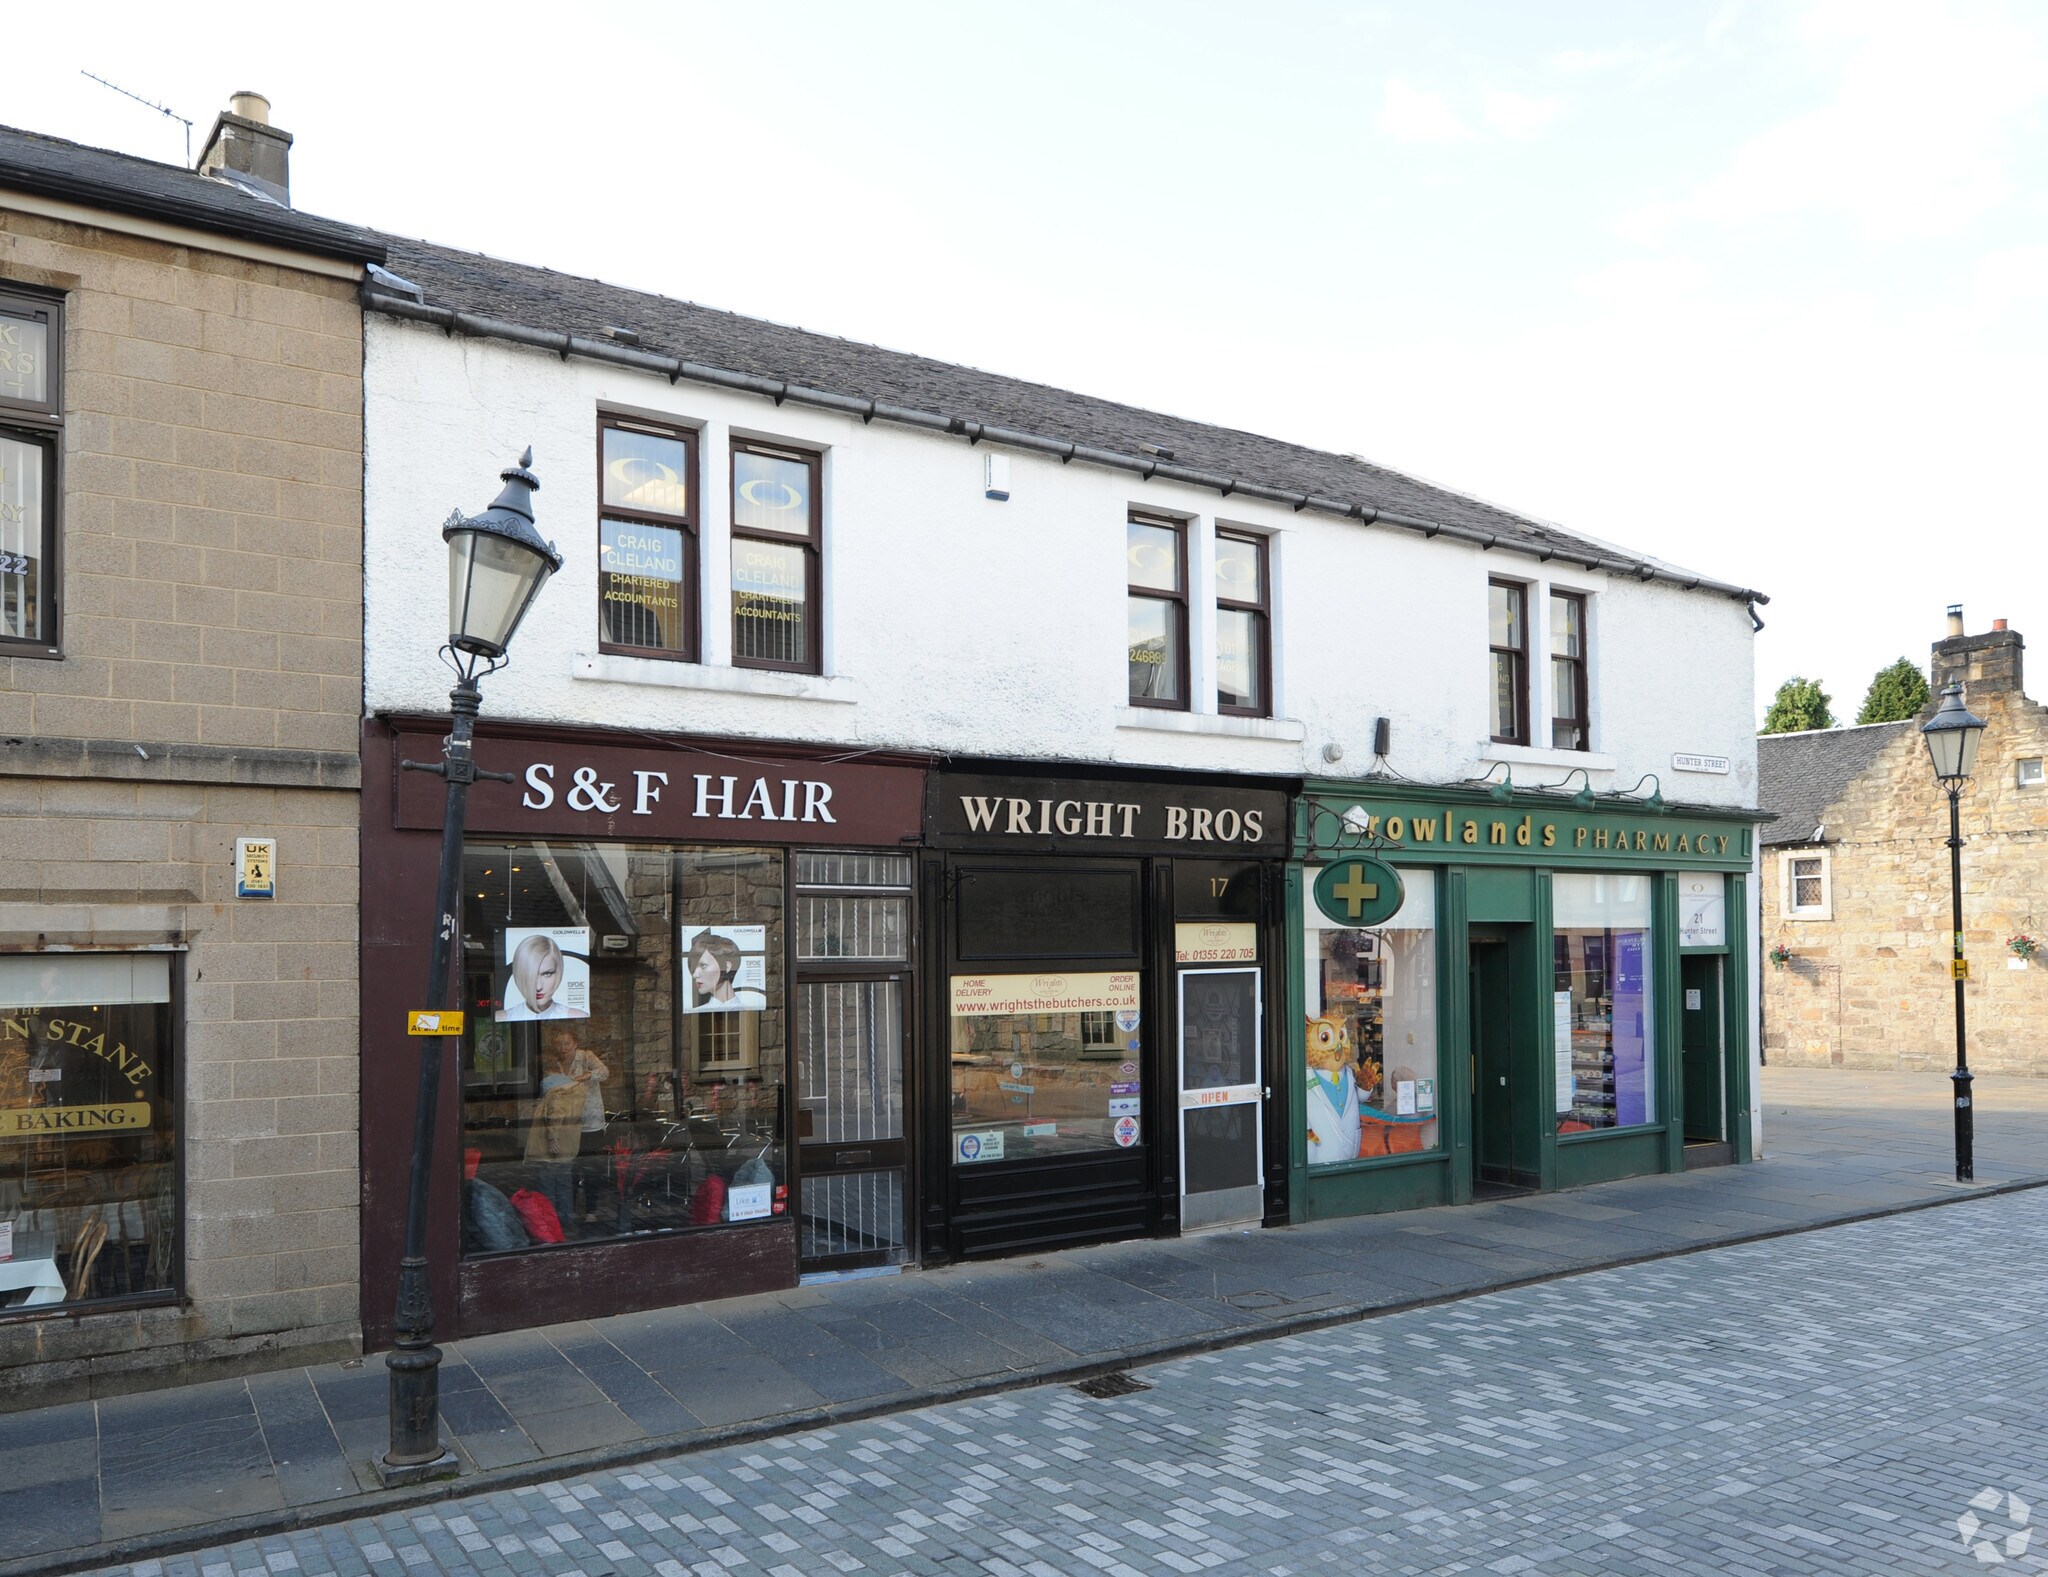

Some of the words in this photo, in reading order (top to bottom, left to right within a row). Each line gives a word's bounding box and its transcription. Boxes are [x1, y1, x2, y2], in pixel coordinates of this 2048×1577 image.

[617, 534, 662, 552] CRAIG
[606, 551, 676, 572] CLELAND
[745, 553, 786, 570] CRAIG
[610, 573, 670, 590] CHARTERED
[736, 568, 800, 588] CLELAND
[604, 590, 678, 608] ACCOUNTANTS
[739, 590, 795, 606] CHARTERED
[734, 606, 802, 623] ACCOUNTANTS
[1129, 648, 1168, 665] 246889
[1676, 756, 1702, 767] HUNTER
[1704, 758, 1727, 769] STREET
[692, 774, 837, 824] HAIR
[959, 795, 1141, 838] WRIGHT
[1163, 806, 1264, 842] BROS
[1366, 810, 1556, 847] rowlands
[1576, 827, 1729, 855] PHARMACY
[246, 845, 268, 854] UK
[1210, 878, 1229, 897] 17
[1694, 912, 1703, 924] 21
[1679, 927, 1700, 935] Hunter
[1700, 926, 1718, 935] Street
[1175, 950, 1190, 961] Tel:
[1192, 949, 1218, 960] 01355
[1220, 948, 1237, 959] 220
[1239, 947, 1255, 958] 705
[963, 979, 986, 988] HOME
[1109, 975, 1134, 983] ORDER
[955, 988, 993, 997] DELIVERY
[1108, 984, 1136, 992] ONLINE
[13, 1007, 41, 1016] THE
[955, 995, 1136, 1014] www.wrightsthebutchers.co.uk
[46, 1018, 153, 1086] STANE
[1201, 1091, 1229, 1104] OPEN
[736, 1197, 750, 1205] Like
